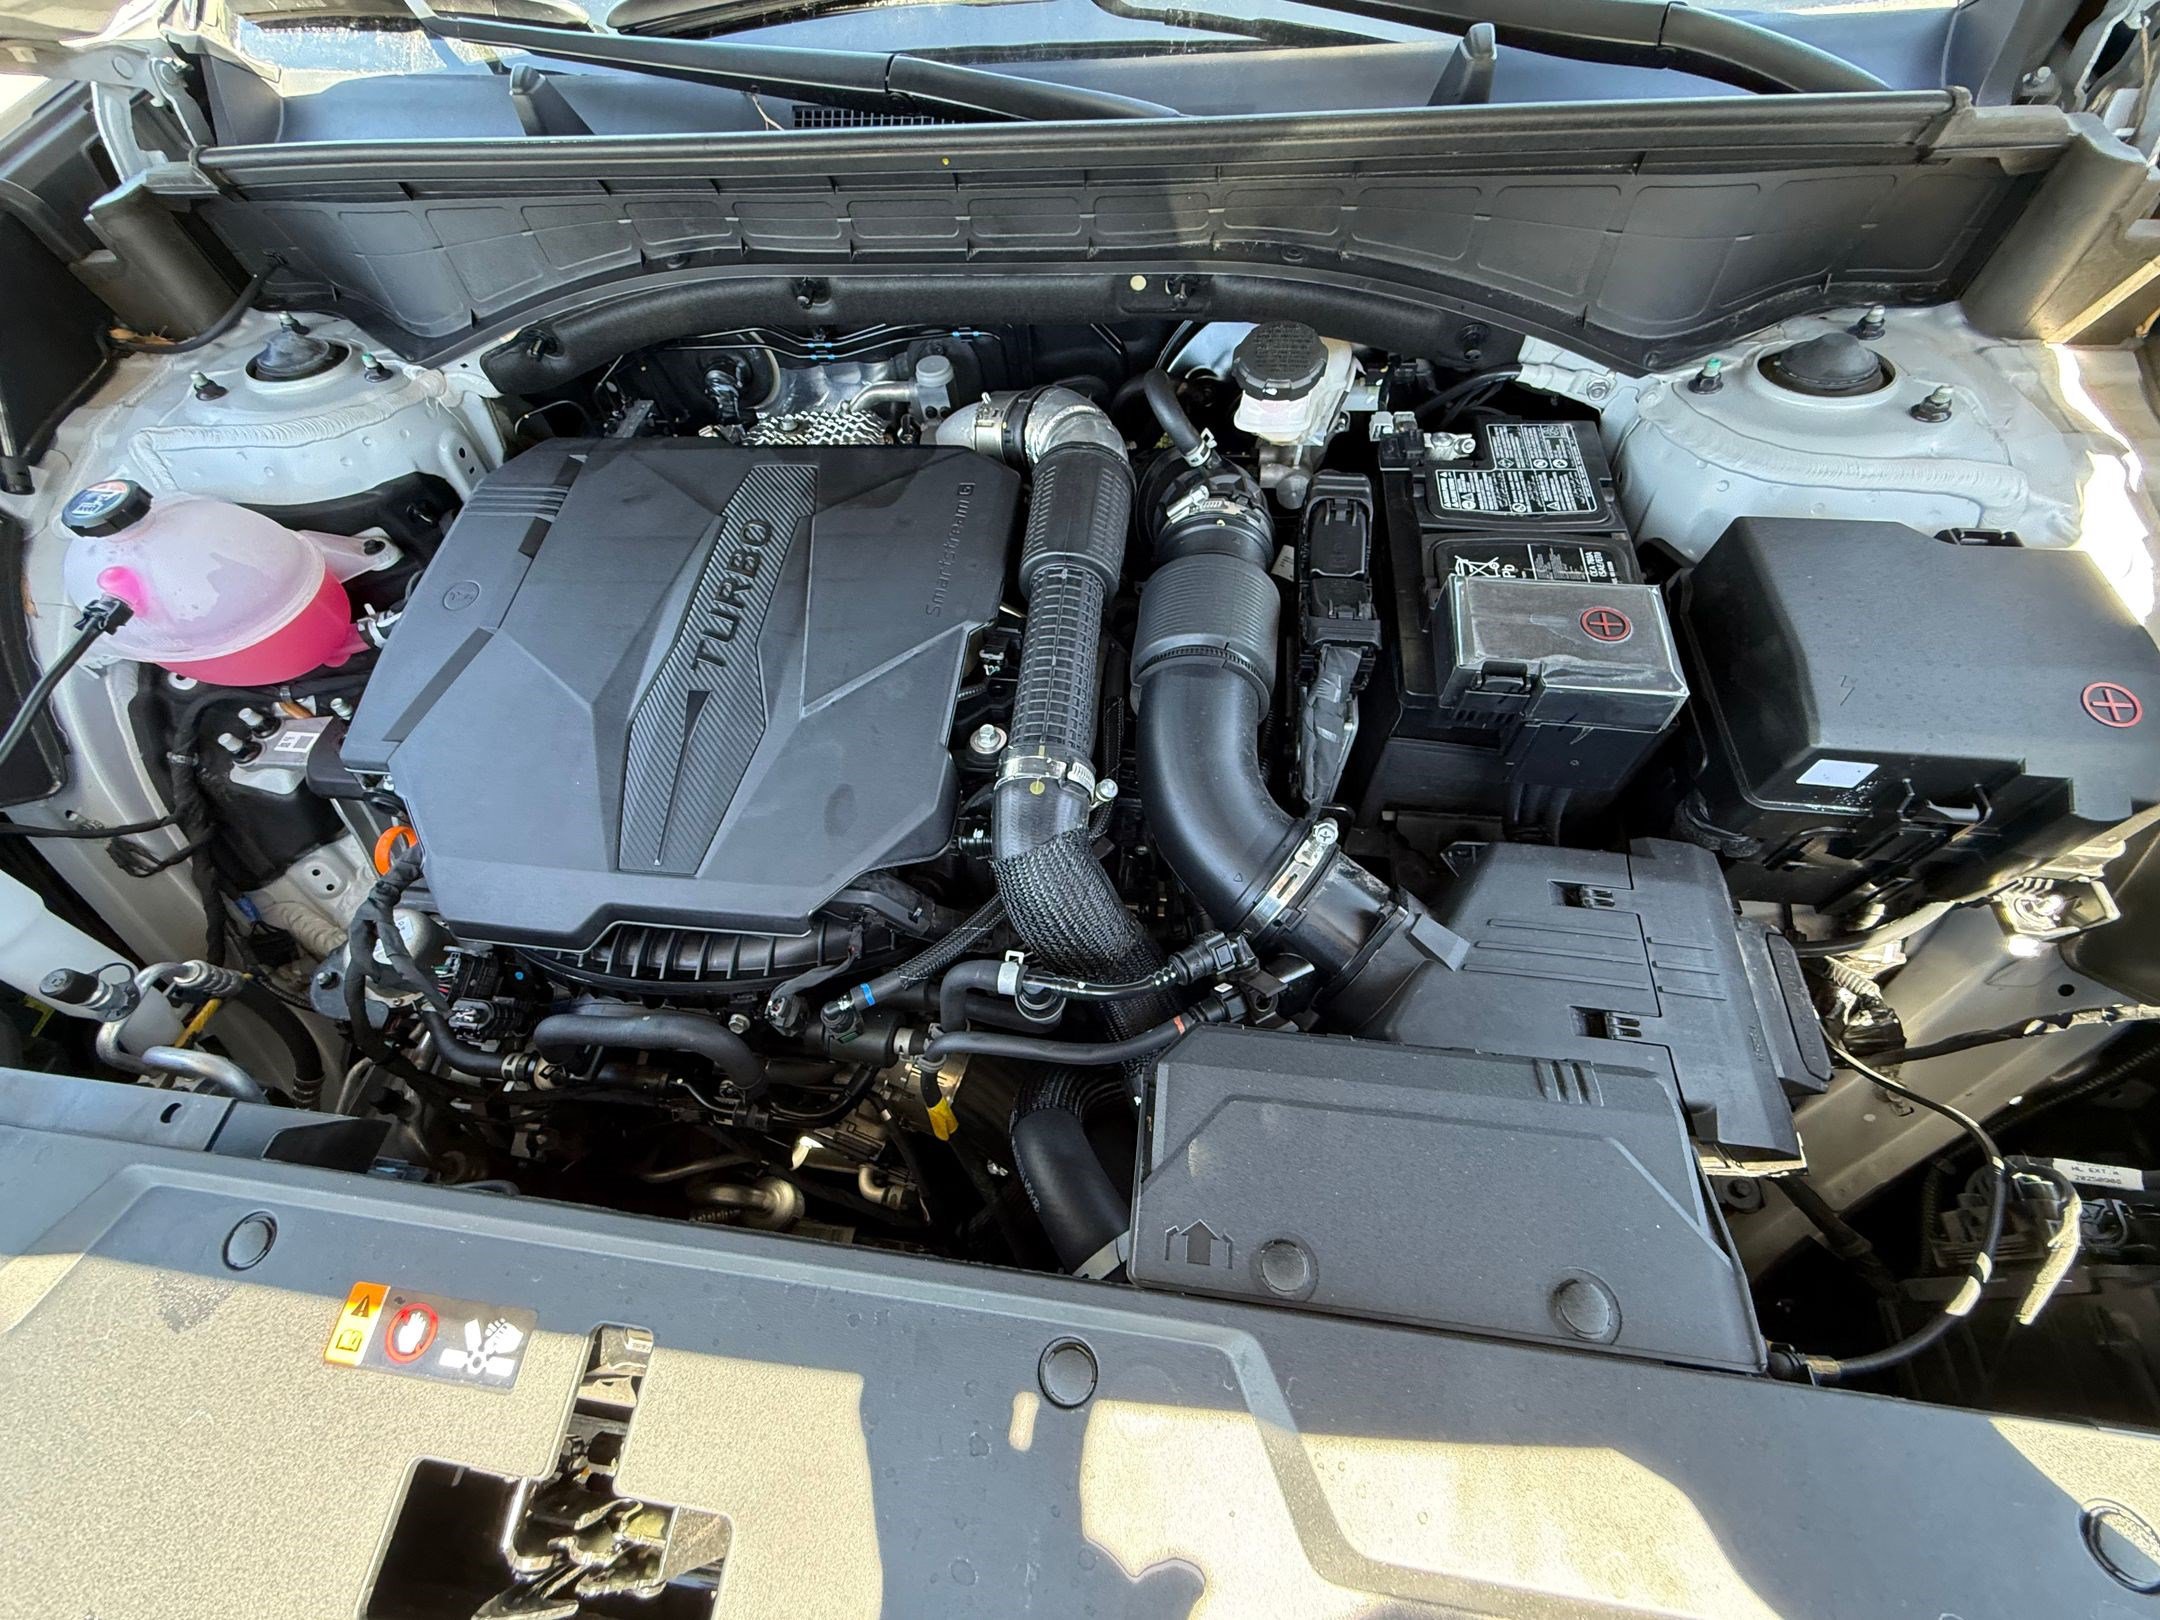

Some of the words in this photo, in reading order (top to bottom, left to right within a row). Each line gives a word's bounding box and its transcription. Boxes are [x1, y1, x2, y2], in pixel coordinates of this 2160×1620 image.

[690, 519, 772, 671] TURBO
[926, 499, 970, 617] Smartstream
[1501, 564, 1516, 578] Pb
